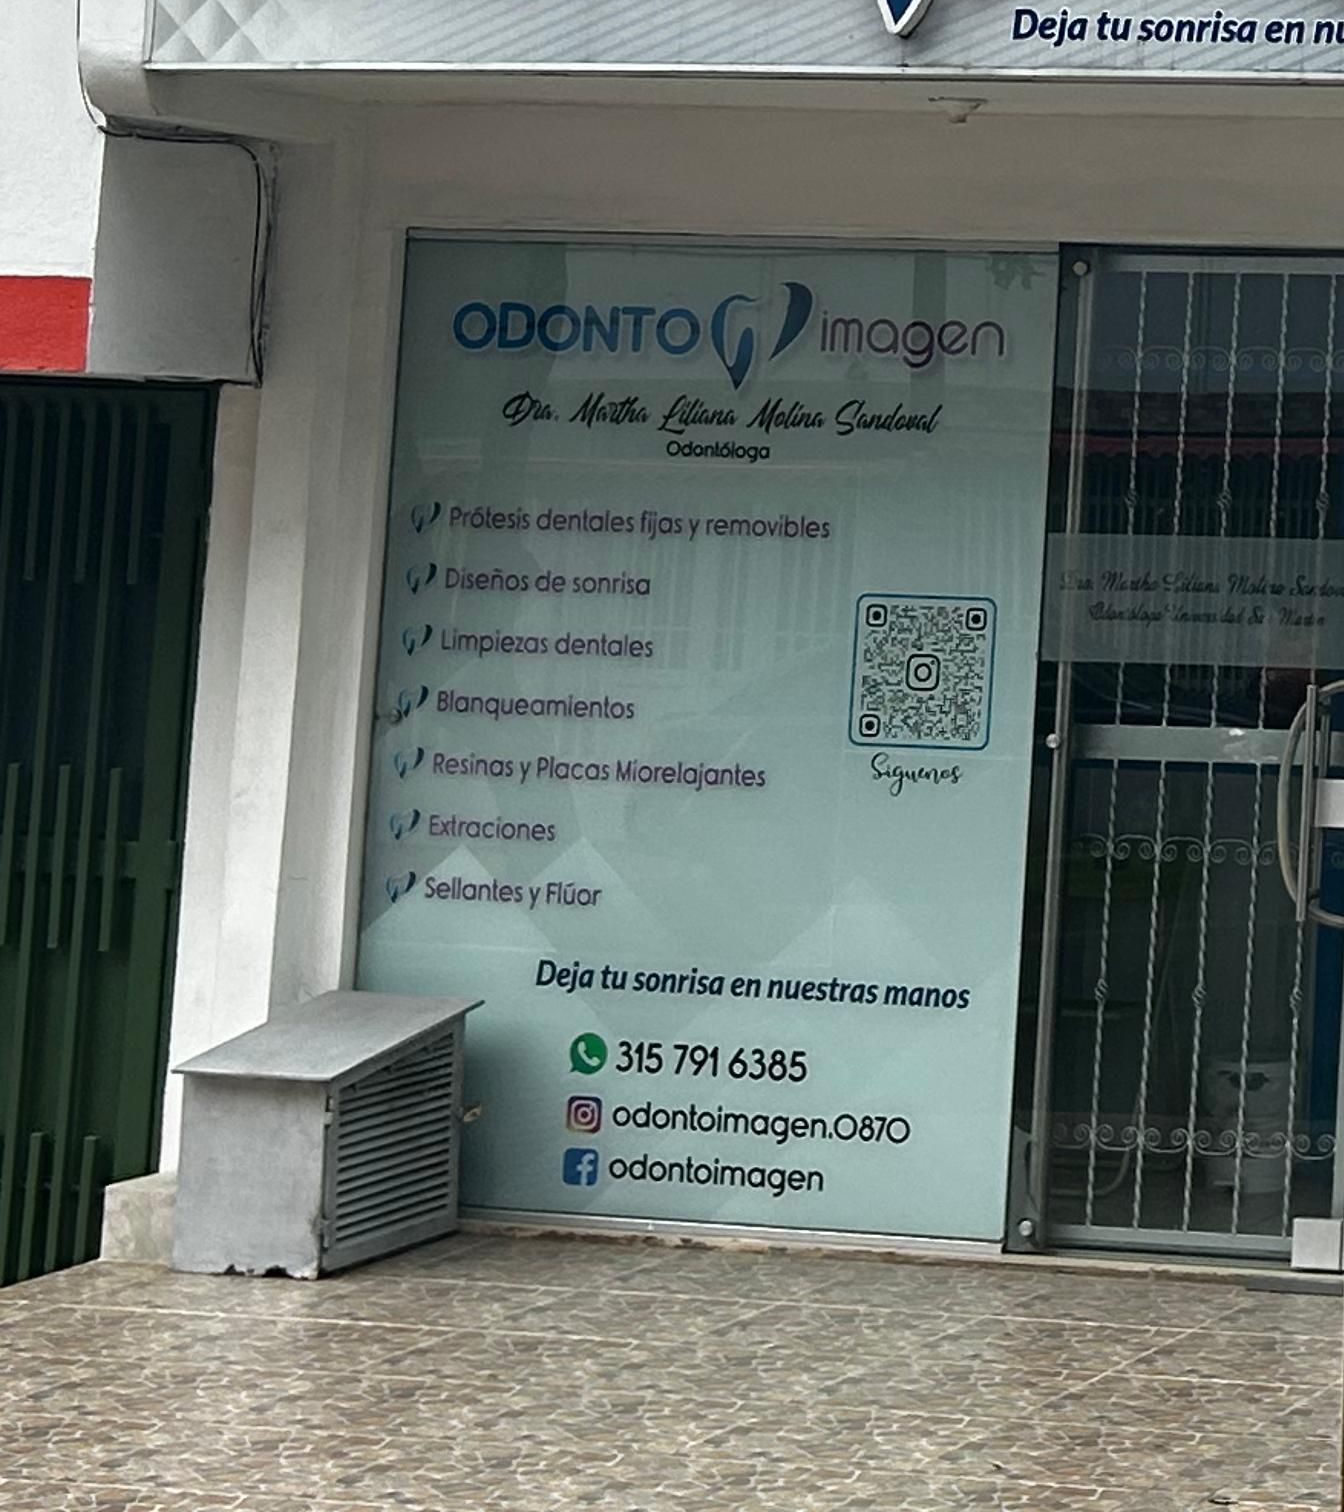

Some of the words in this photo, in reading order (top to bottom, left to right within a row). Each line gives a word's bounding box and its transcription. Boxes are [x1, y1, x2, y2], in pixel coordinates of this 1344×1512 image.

[1012, 9, 1088, 48] Deja
[1097, 12, 1131, 44] tu
[1138, 10, 1256, 45] sonrisa
[1265, 19, 1305, 45] en
[452, 302, 701, 353] ODONTO
[820, 308, 1006, 369] imagen
[502, 390, 559, 427] Dra.
[569, 391, 650, 427] Martha
[657, 393, 739, 434] Liliana
[747, 397, 824, 431] Molina
[834, 399, 940, 436] Sandoval
[665, 439, 771, 463] Odontóloga
[448, 505, 530, 533] Prótesis
[535, 506, 636, 534] dentales
[640, 509, 683, 539] fijas
[687, 518, 701, 539] y
[705, 514, 831, 540] removibles
[444, 566, 530, 594] Diseños
[535, 568, 567, 594] de
[571, 572, 652, 596] sonrisa
[440, 628, 549, 659] Limpiezas
[554, 632, 654, 659] dentales
[436, 690, 637, 723] Blanqueamientos
[432, 752, 514, 780] Resinas
[519, 761, 533, 785] y
[535, 756, 611, 783] Placas
[616, 759, 767, 792] Miorelajantes
[428, 815, 557, 844] Extraciones
[423, 876, 524, 905] Sellantes
[528, 886, 542, 910] y
[545, 880, 602, 908] Flúor
[535, 958, 595, 993] Deja
[600, 963, 629, 991] tu
[633, 967, 726, 996] sonrisa
[730, 974, 762, 999] en
[767, 974, 878, 1005] nuestras
[883, 981, 971, 1009] manos
[614, 1040, 665, 1073] 315
[673, 1044, 721, 1078] 791
[727, 1046, 808, 1082] 6385
[611, 1100, 912, 1145] odontoimagen.0870
[608, 1155, 824, 1198] odontoimagen
